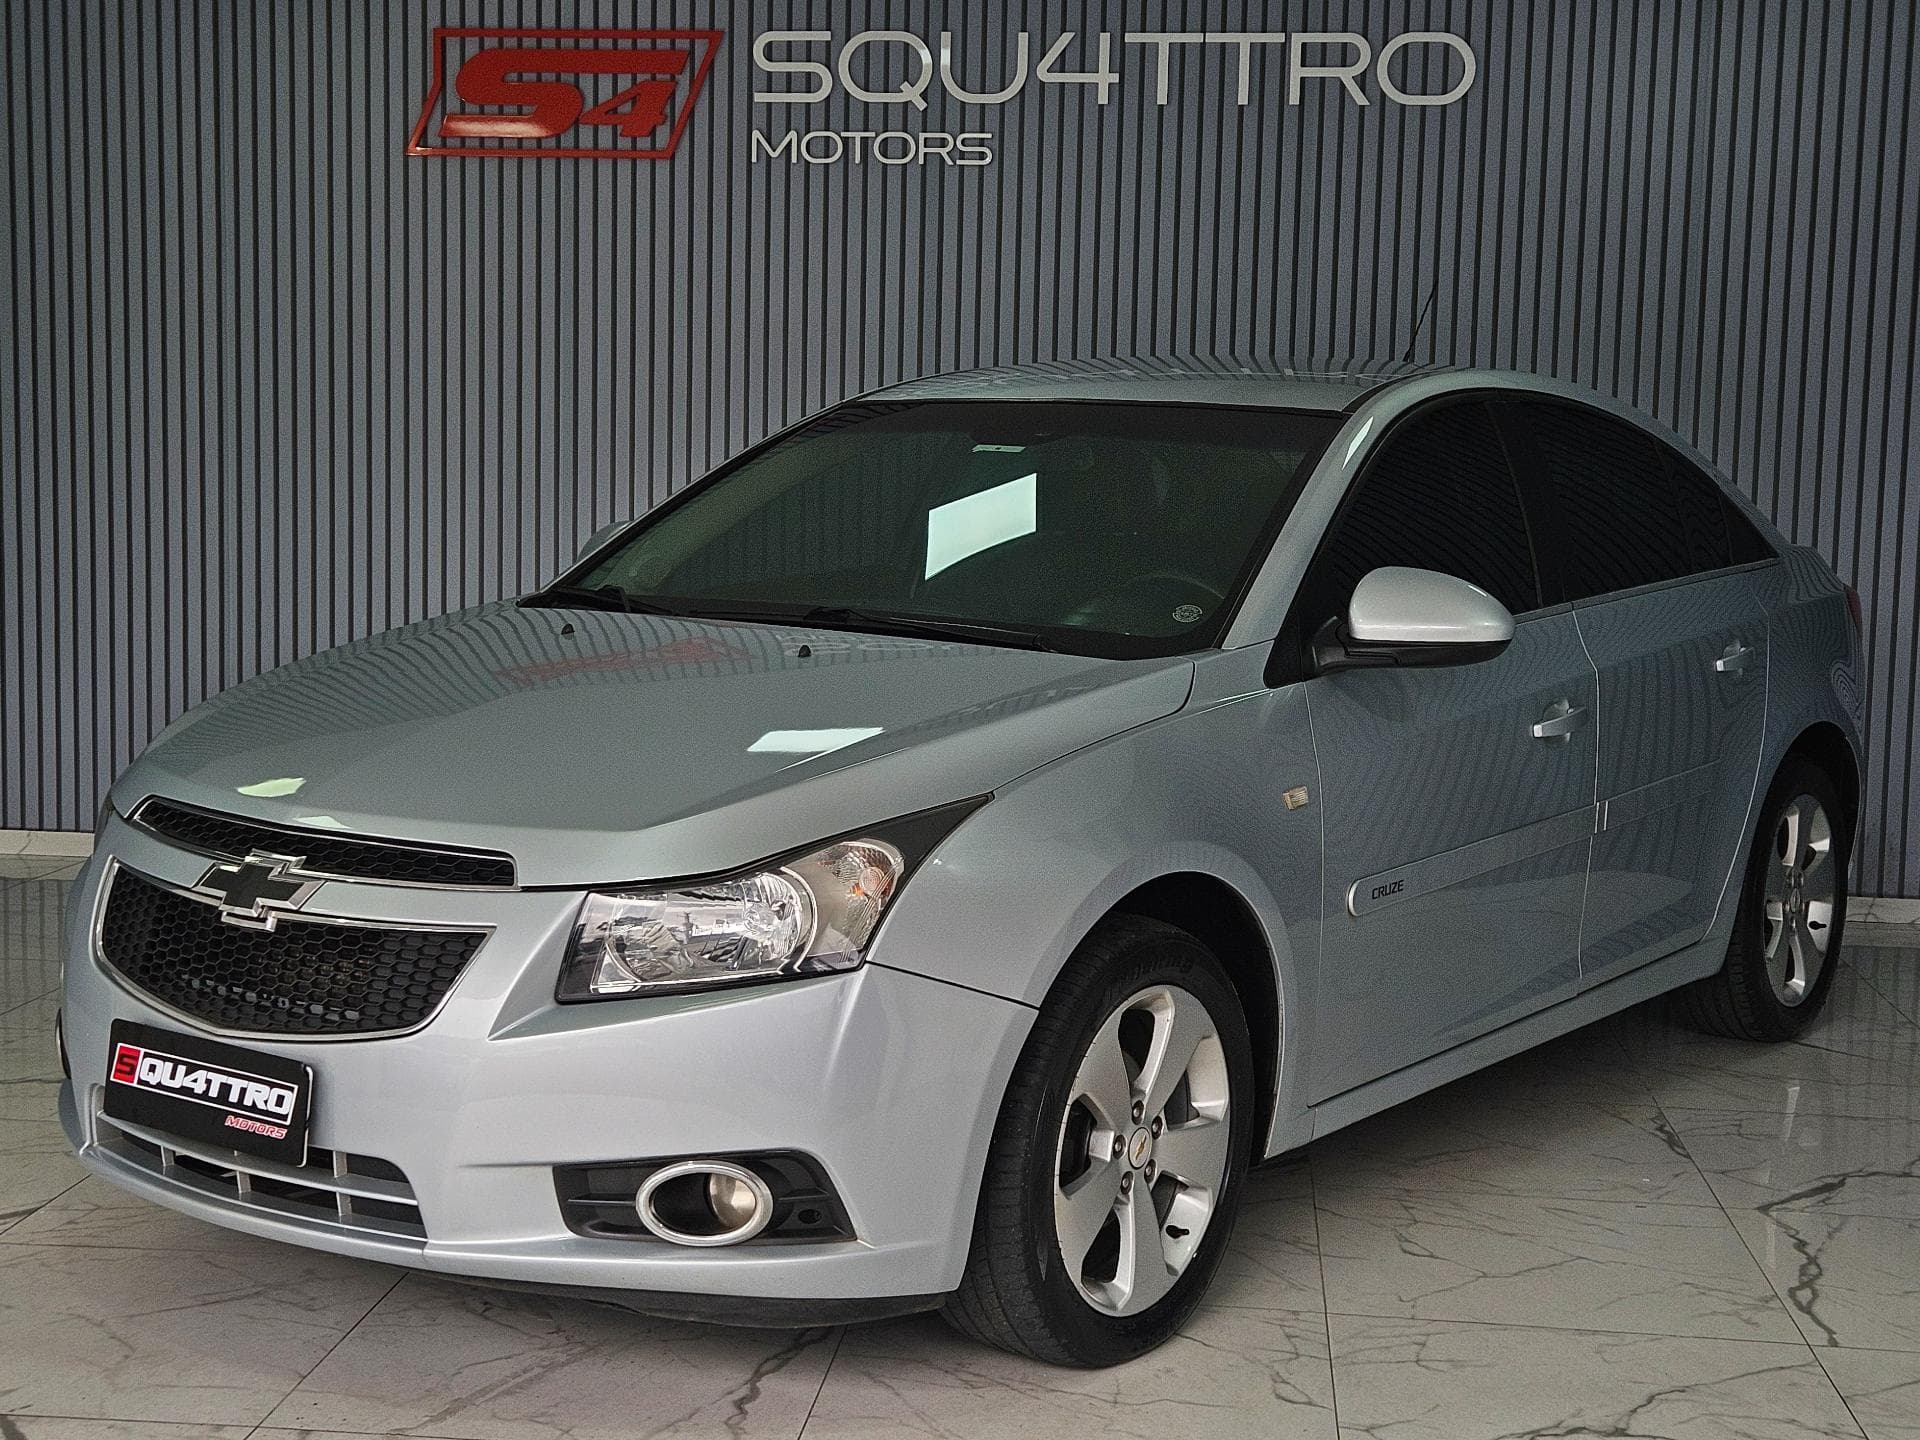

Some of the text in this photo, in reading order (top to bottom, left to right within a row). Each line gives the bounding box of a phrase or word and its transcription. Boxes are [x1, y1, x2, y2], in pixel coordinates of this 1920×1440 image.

[438, 48, 691, 138] S4
[753, 31, 1477, 111] SQU4TTRO
[751, 129, 993, 166] MOTORS
[1371, 880, 1404, 900] CRUZE
[113, 1053, 295, 1115] SQU4TTRO
[224, 1115, 288, 1140] MOTORS
